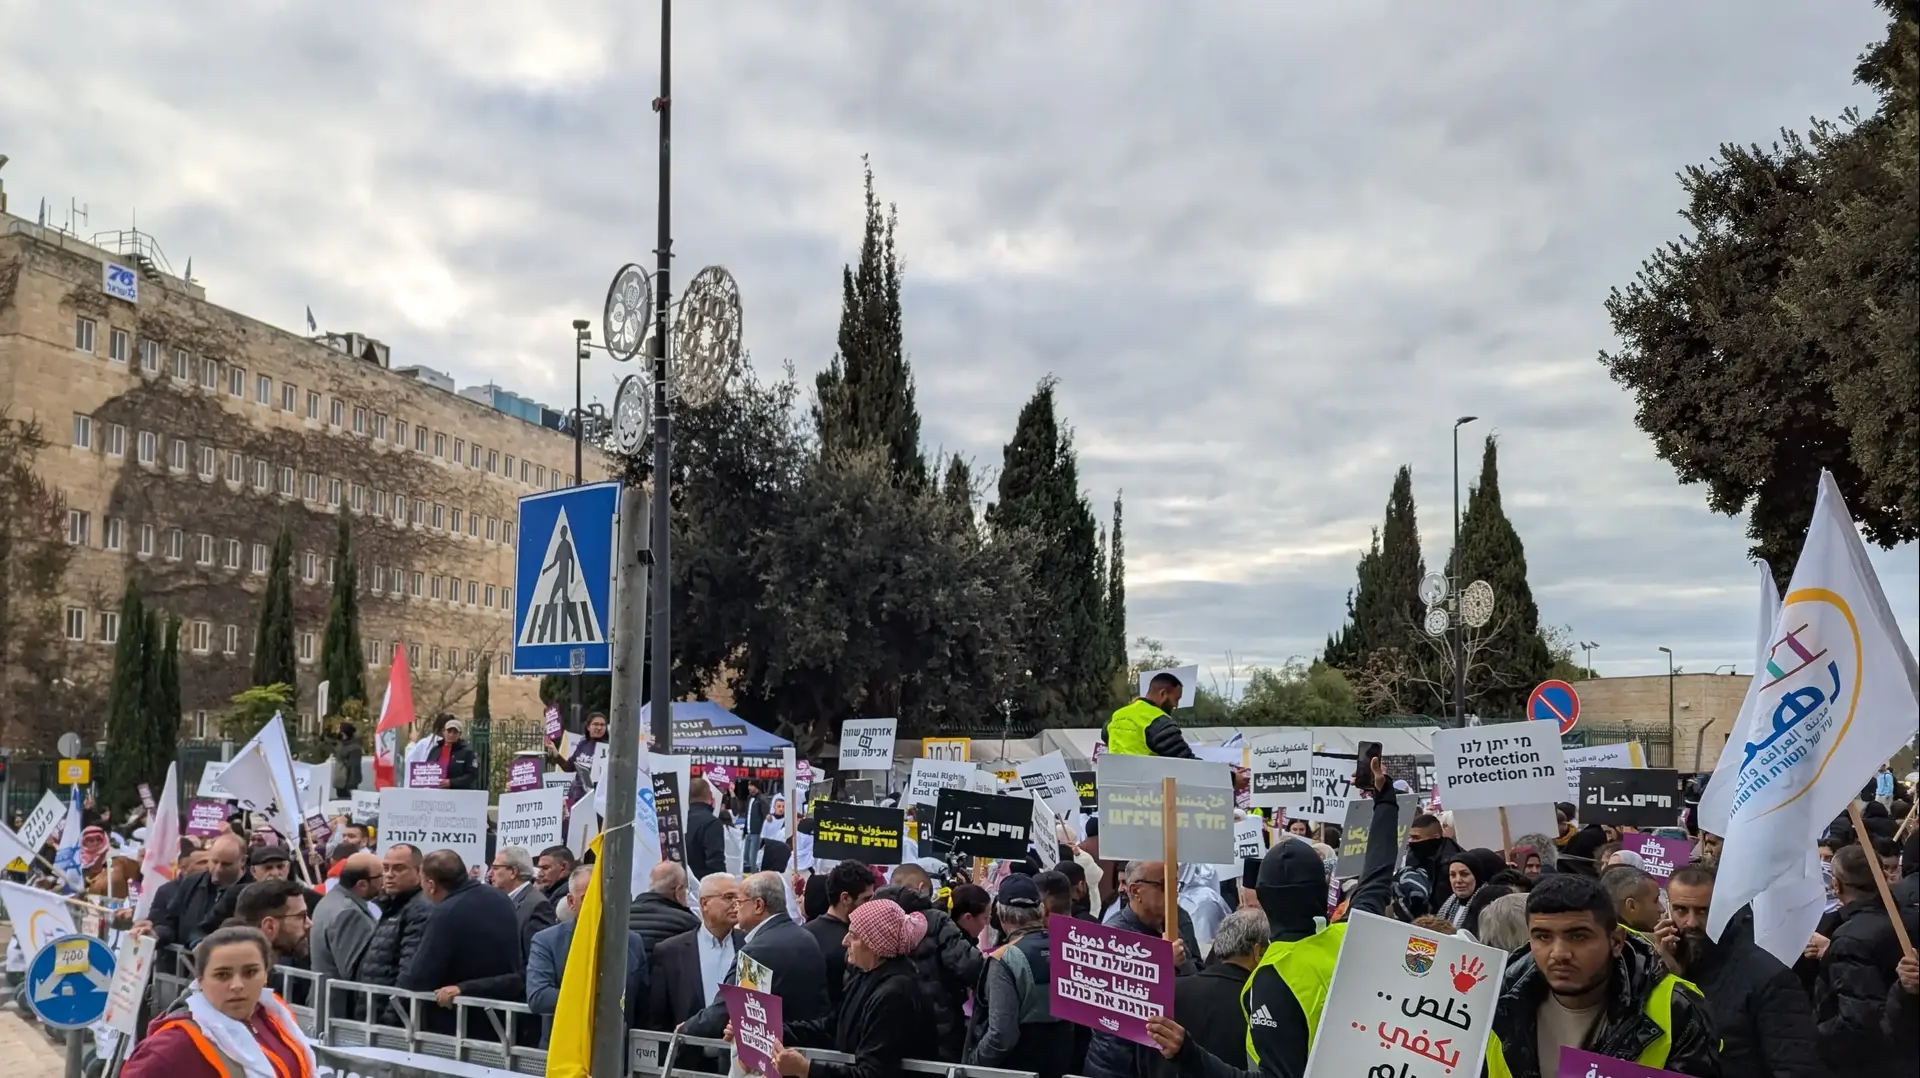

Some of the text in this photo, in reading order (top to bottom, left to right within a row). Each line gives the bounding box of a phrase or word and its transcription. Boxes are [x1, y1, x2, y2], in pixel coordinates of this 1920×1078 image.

[108, 264, 135, 286] 76
[679, 720, 705, 729] our
[1804, 707, 1829, 732] مدينة
[702, 727, 743, 737] Nation
[843, 727, 892, 737] אזרחות שווה
[1460, 736, 1532, 754] מי יתן לנו
[1806, 735, 1821, 749] של
[842, 748, 888, 758] אכיפה שווה
[1457, 751, 1540, 769] Protection
[1268, 758, 1292, 770] الشرطة
[1769, 747, 1807, 779] מסורת
[917, 770, 939, 780] Equal
[1044, 771, 1066, 782] הערבי
[1296, 772, 1305, 785] ما
[1447, 766, 1527, 788] protection
[1532, 765, 1555, 778] מה
[912, 787, 930, 796] End
[918, 779, 940, 789] Equal
[1050, 785, 1067, 795] השר
[1325, 774, 1351, 797] לא
[1326, 798, 1345, 808] מסוג
[1586, 786, 1632, 812] حياة
[516, 801, 543, 813] מדיניות
[24, 806, 44, 839] חוק
[501, 816, 557, 832] ההפקר מתחזקת
[819, 819, 898, 836] مسؤولية مشتركة
[941, 811, 986, 840] حياة
[386, 829, 477, 843] הוצאה להורג
[530, 832, 554, 846] ביטחון
[819, 830, 898, 848] ערבים זה לזה
[1240, 845, 1259, 857] באה
[1642, 846, 1662, 855] ביחד
[1068, 925, 1152, 960] حكومة دموية
[62, 949, 84, 964] 400
[1066, 946, 1156, 979] ממשלת דמים
[1111, 976, 1150, 1000] تقتلنا
[1060, 982, 1160, 1018] הורגת את כולנו
[747, 1006, 764, 1020] ביחד
[1401, 995, 1472, 1031] خلص
[740, 1016, 766, 1038] الجريمة
[742, 1032, 768, 1052] הפשיעה
[1378, 1021, 1461, 1075] بكفي
